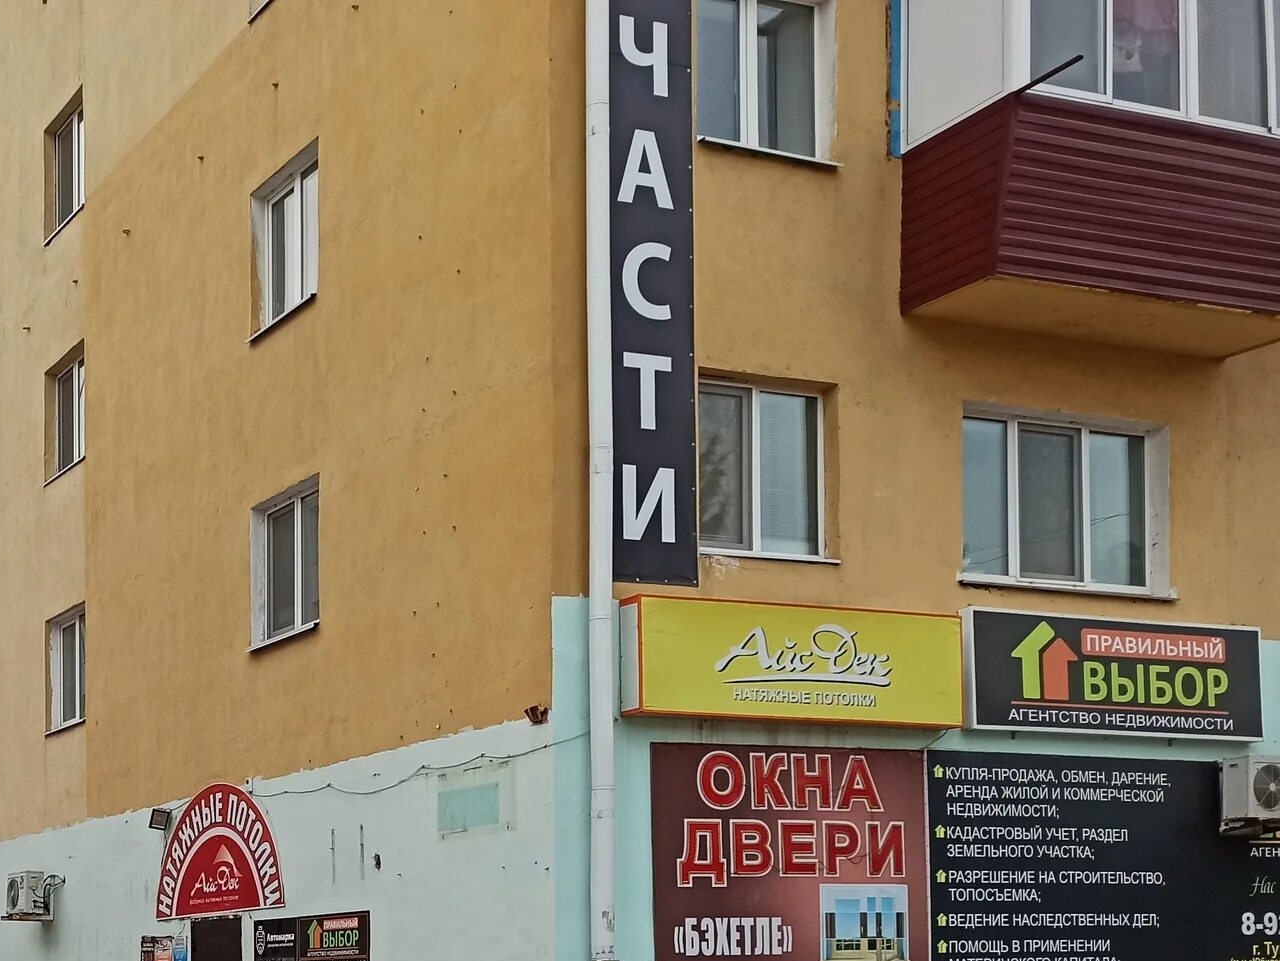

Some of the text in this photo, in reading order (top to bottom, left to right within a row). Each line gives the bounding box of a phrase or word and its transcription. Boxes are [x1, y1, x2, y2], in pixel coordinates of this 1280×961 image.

[617, 14, 676, 544] ЧАСТИ
[1086, 634, 1223, 660] ПРАВИЛЬНЫЙ
[1082, 660, 1229, 707] ВЫБОР
[733, 688, 877, 707] НАТЯЖНЫЕ ПОТОЛКИ
[1008, 708, 1234, 731] АГЕНТСТВО НЕДВИЖИМОСТИ
[696, 750, 884, 811] ОКНА
[945, 767, 1171, 787] КУПЛЯ-ПРОДАЖА, ОБМЕН, ДАРЕНИЕ,
[946, 784, 1164, 803] АРЕНДА ЖИЛОЙ И КОММЕРЧЕСКОЙ
[947, 803, 1060, 819] НЕДВИЖИМОСТИ;
[946, 825, 1129, 843] КАДАСТРОВЫЙ УЧЕТ, РАЗДЕЛ
[158, 792, 281, 916] НАТЯЖНЫЕ ПОТОЛКИ
[676, 818, 906, 887] ДВЕРИ
[947, 844, 1095, 860] ЗЕМЕЛЬНОГО УЧАСТКА;
[948, 870, 1166, 886] РАЗРЕШЕНИЕ НА СТРОИТЕЛЬСТВО,
[948, 888, 1041, 903] ТОПОСЪЕМКА;
[948, 914, 1160, 929] ВЕДЕНИЕ НАСЛЕДСТВЕННЫХ ДЕЛ;
[1241, 912, 1280, 936] 8-9
[322, 930, 359, 948] ВЫБОР
[673, 916, 793, 957] «БЭХЕТЛЕ»
[949, 939, 1111, 955] ПОМОЩЬ В ПРИМЕНЕНИИ
